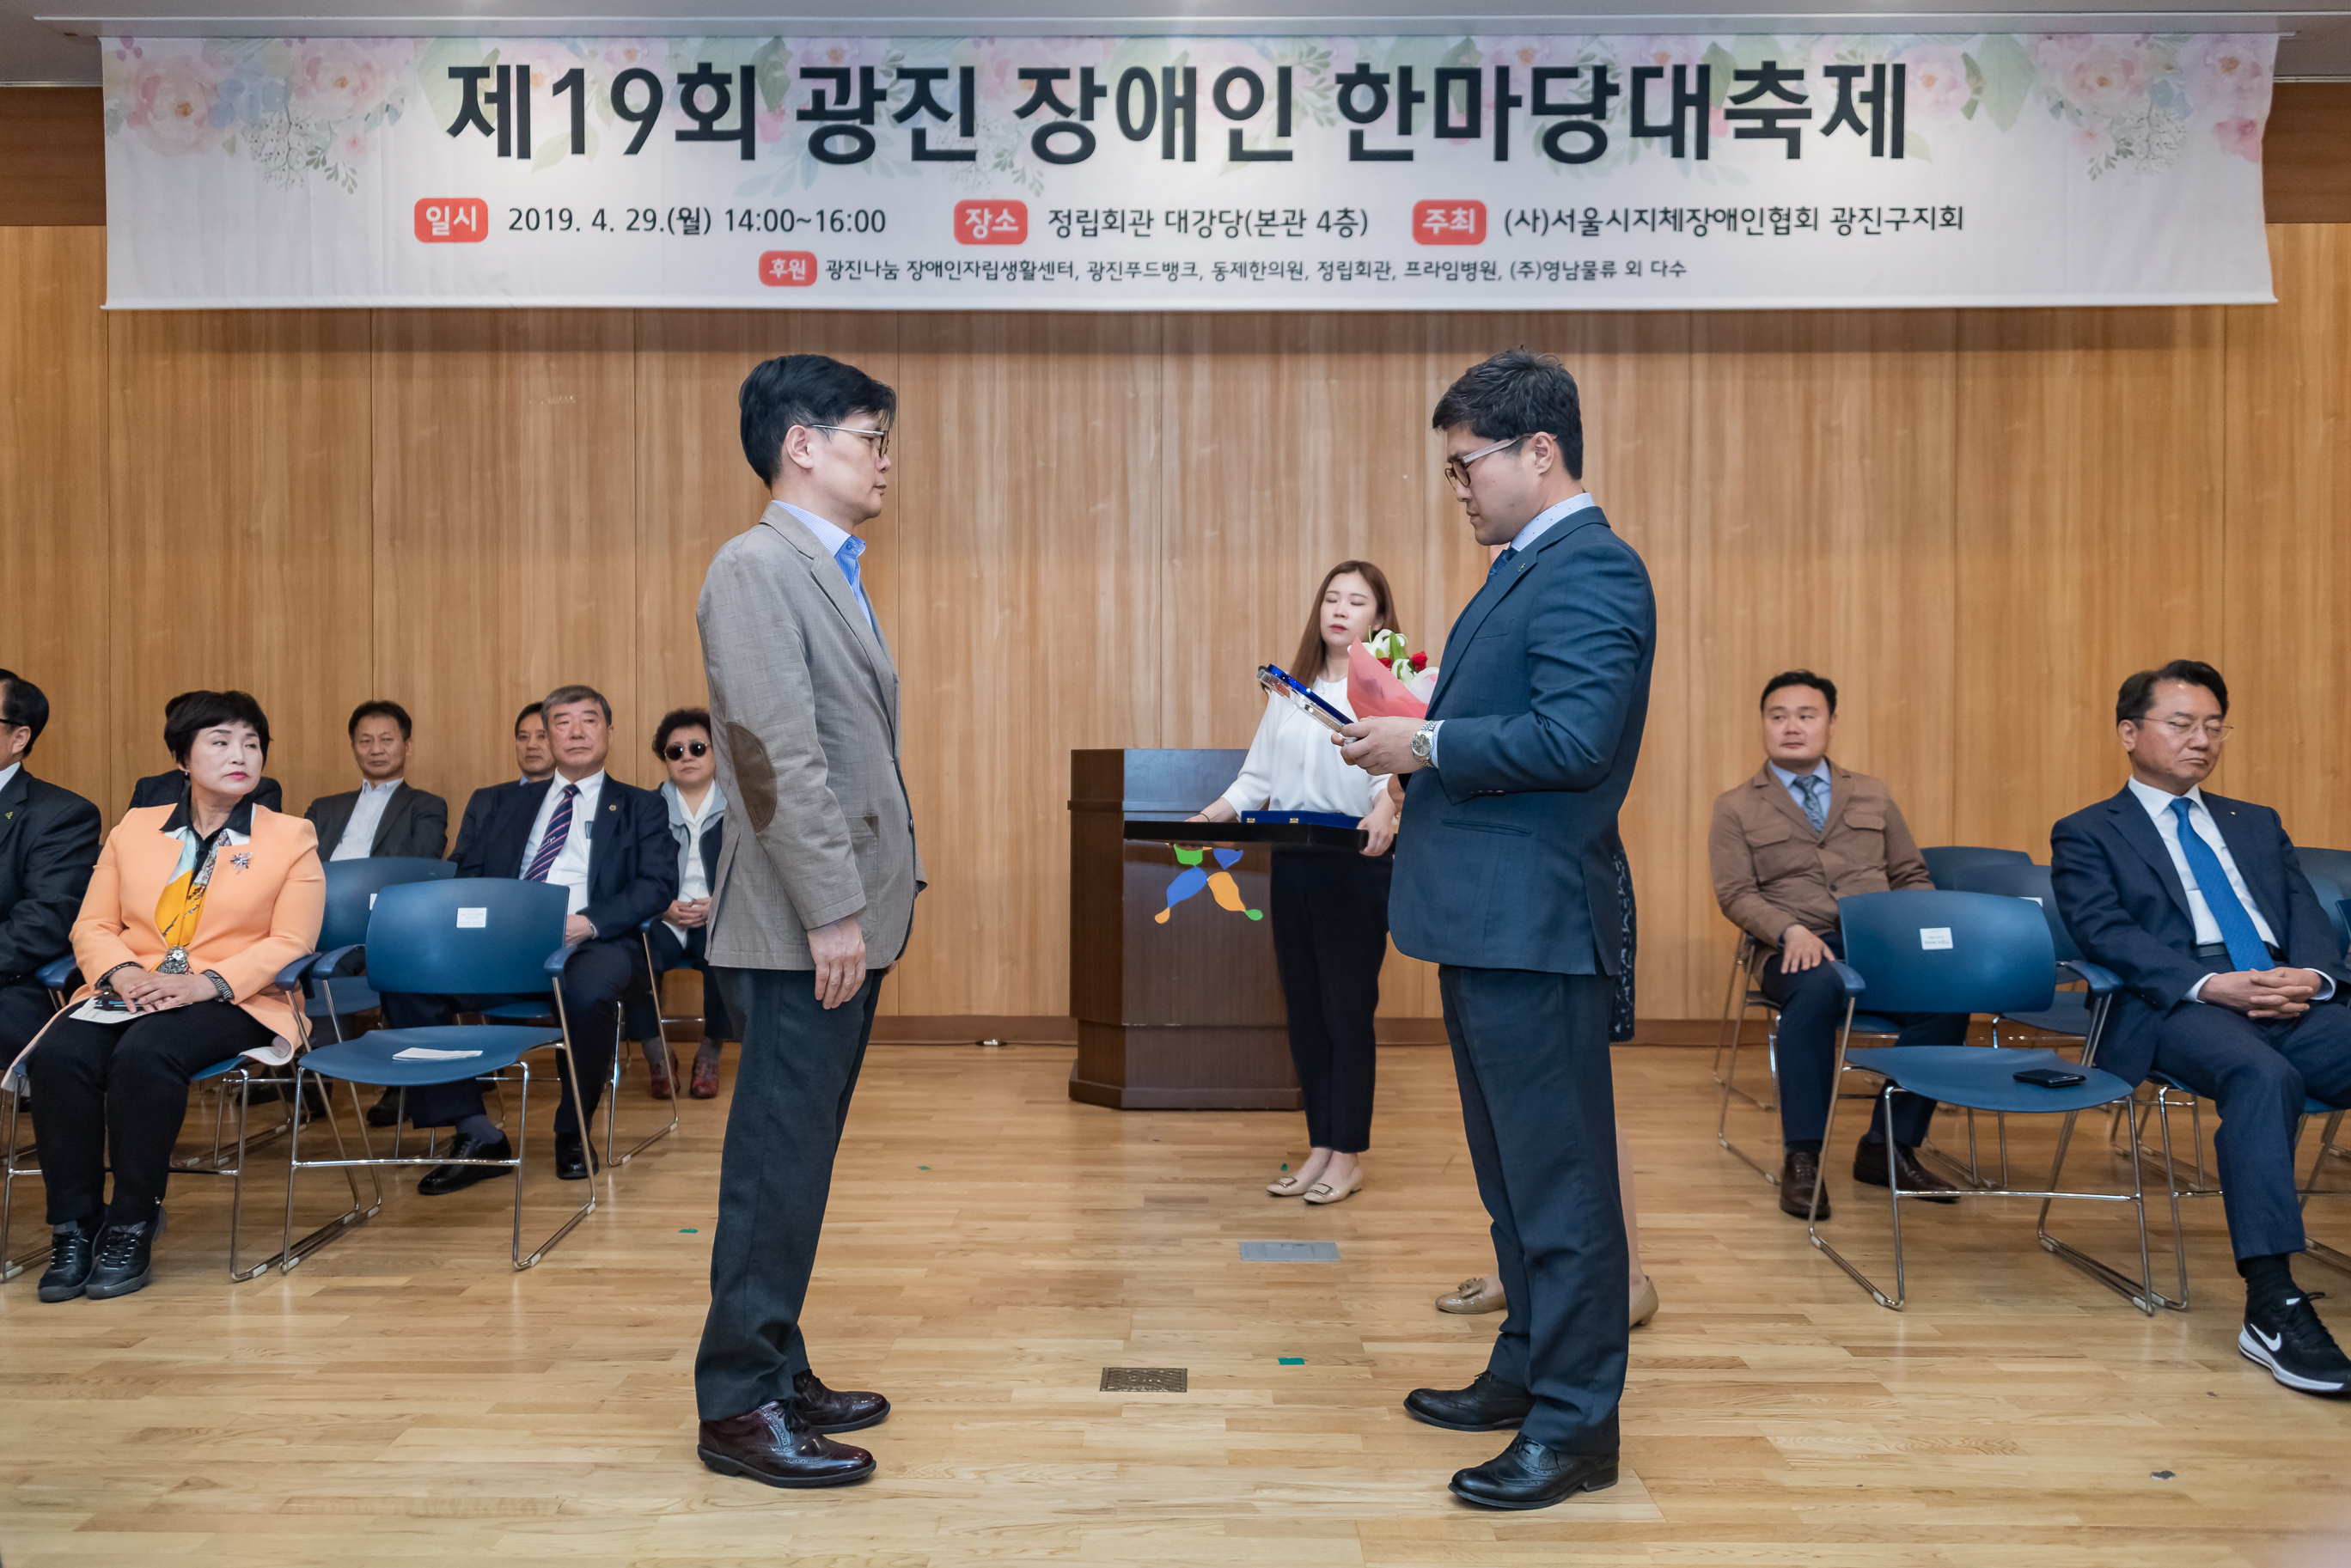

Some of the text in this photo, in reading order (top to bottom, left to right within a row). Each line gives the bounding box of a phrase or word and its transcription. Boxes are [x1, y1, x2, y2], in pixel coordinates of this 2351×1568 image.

[447, 61, 1907, 166] 제19회 광진 장애인 한마당대축제
[425, 204, 886, 236] 일시 2019. 4. 29.(월) 14:00~16:00
[964, 206, 1370, 240] 장소 정립회관 대강당(본관 4층)
[1422, 204, 1964, 238] 주최 (사)서울시지체장애인협회 광진구지회
[768, 257, 1688, 283] 후원 광진나눔 장애인자립생활센터, 광진푸드뱅크, 동제한의원, 정립회관, 프라임병원, (주)영남물류 외 다수
